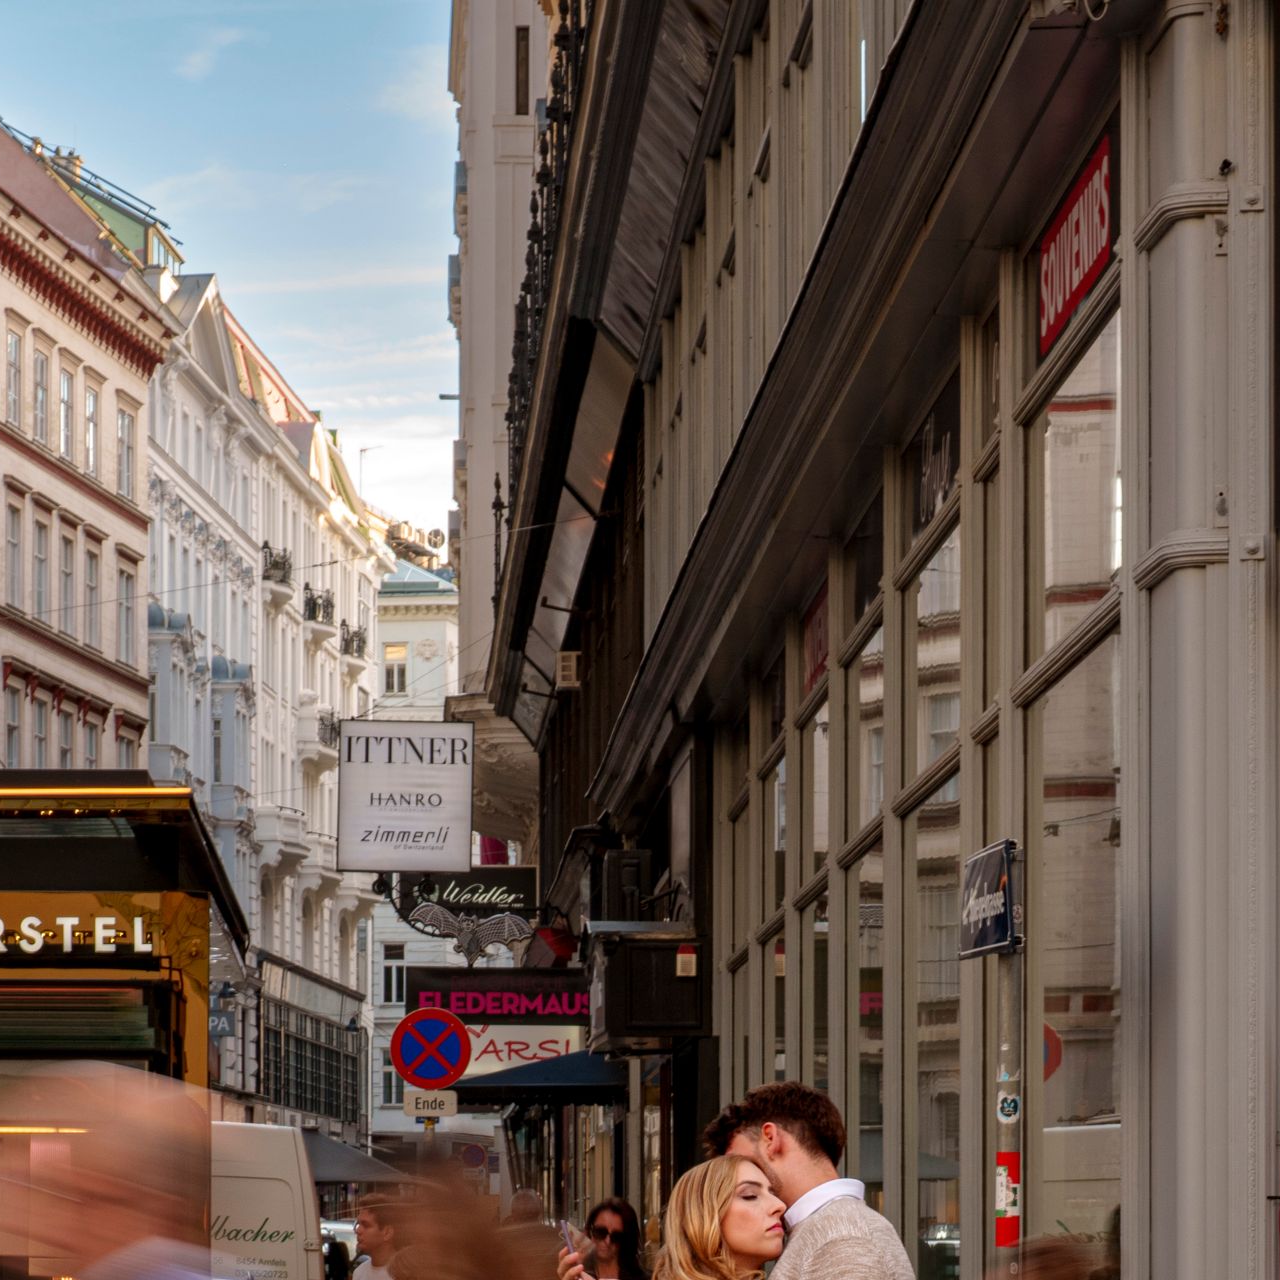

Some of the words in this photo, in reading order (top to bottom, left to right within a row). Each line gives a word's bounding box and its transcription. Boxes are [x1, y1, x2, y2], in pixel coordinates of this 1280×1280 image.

[1040, 154, 1110, 338] SOUVENIRS
[344, 735, 470, 766] ITTNER
[370, 792, 443, 807] HANRO
[361, 825, 450, 844] zimmerli
[442, 879, 524, 905] Weidler
[414, 1097, 446, 1111] Ende
